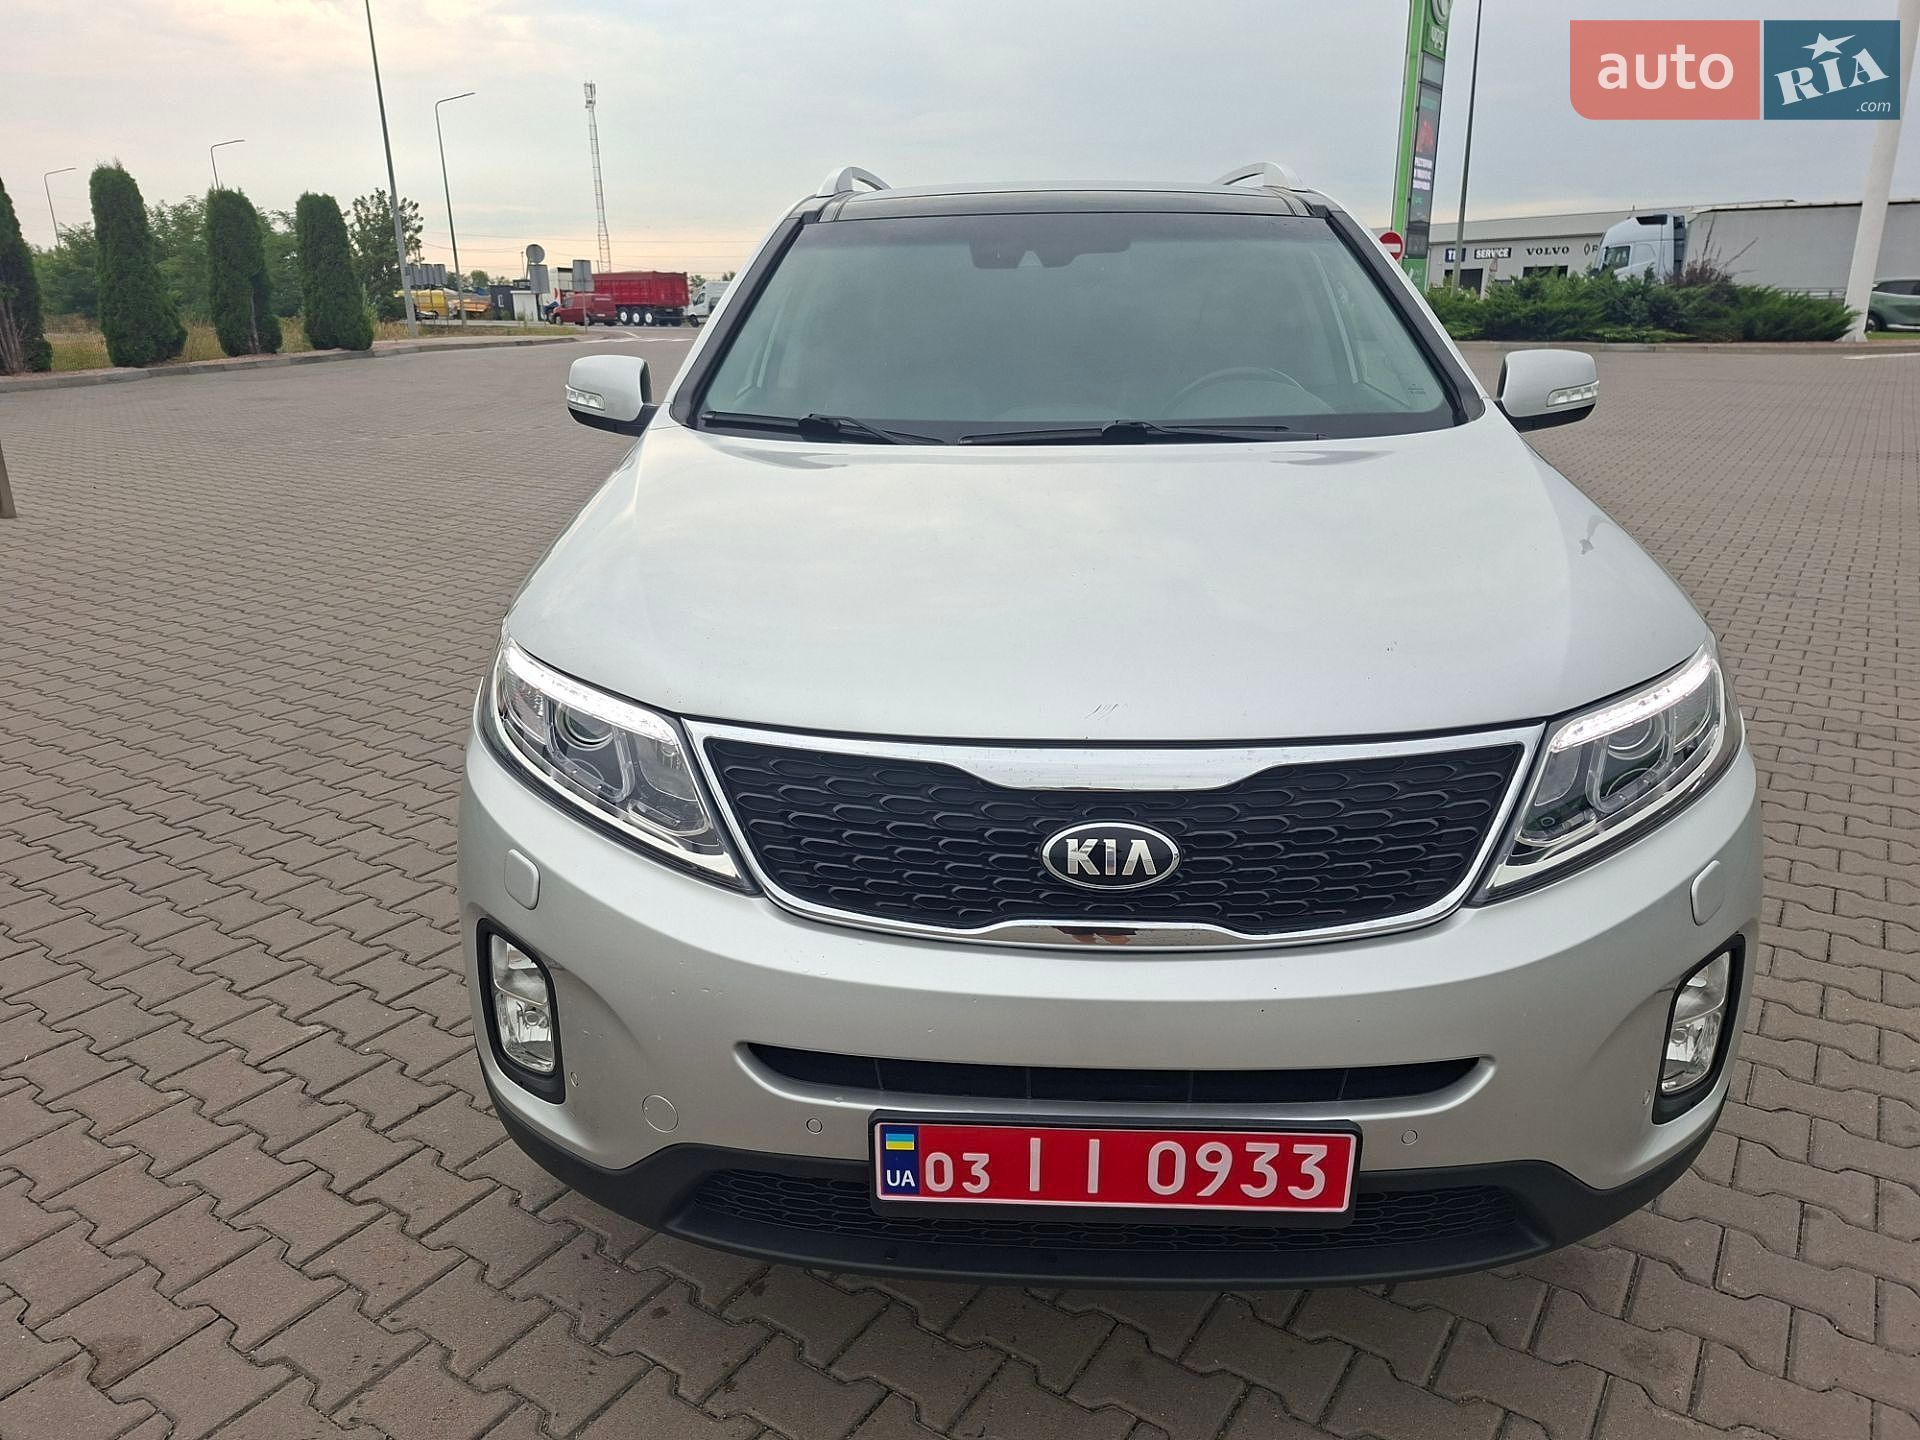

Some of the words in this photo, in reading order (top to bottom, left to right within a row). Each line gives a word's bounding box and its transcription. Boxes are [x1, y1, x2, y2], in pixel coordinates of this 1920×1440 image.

[1475, 248, 1509, 258] SERVICE
[1526, 246, 1570, 256] VOLVO
[1065, 838, 1158, 876] KIA
[886, 1169, 916, 1188] UA
[924, 1152, 991, 1194] 03
[1146, 1140, 1328, 1201] 0933
